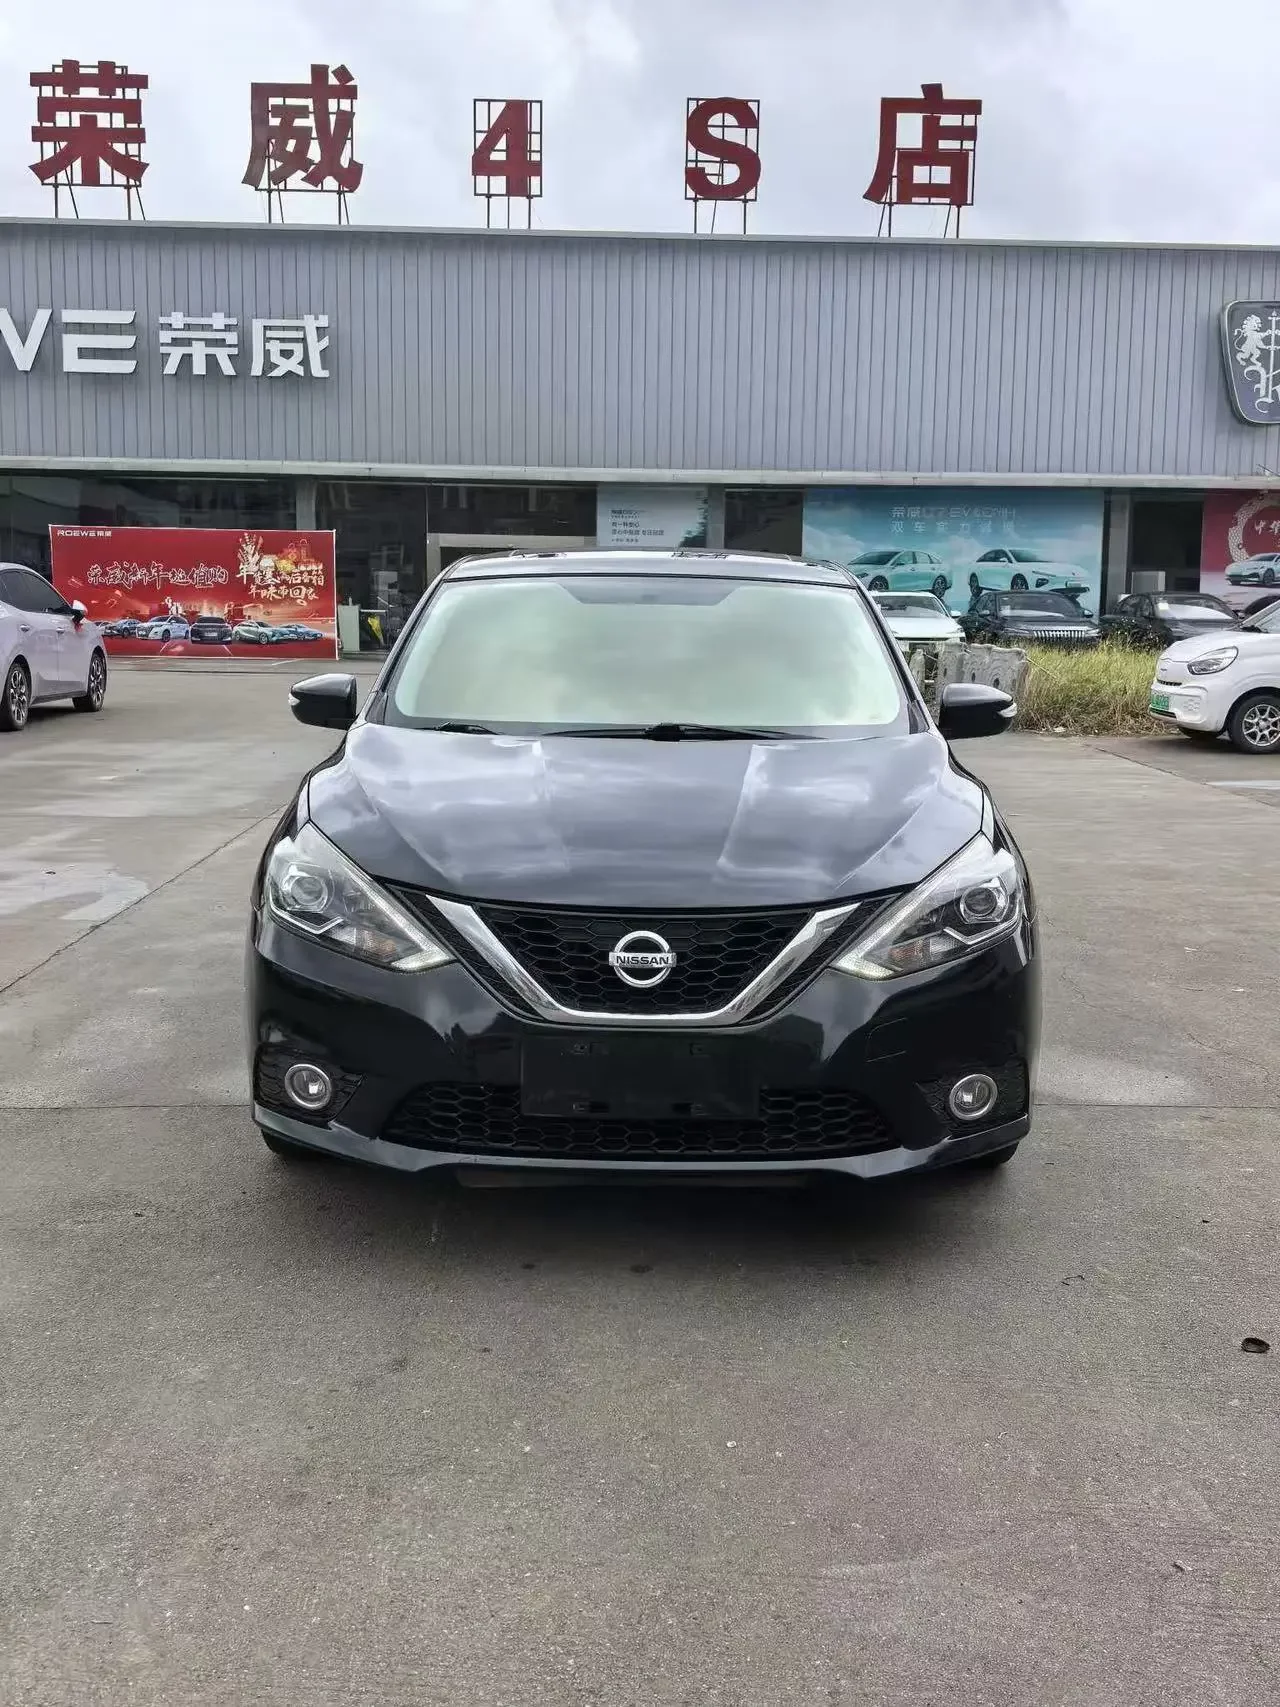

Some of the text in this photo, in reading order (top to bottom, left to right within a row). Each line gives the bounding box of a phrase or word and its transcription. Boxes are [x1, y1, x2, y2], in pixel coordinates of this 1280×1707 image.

[158, 312, 330, 378] 荣威
[57, 529, 96, 537] ROEWE
[616, 955, 669, 965] NISSAN
